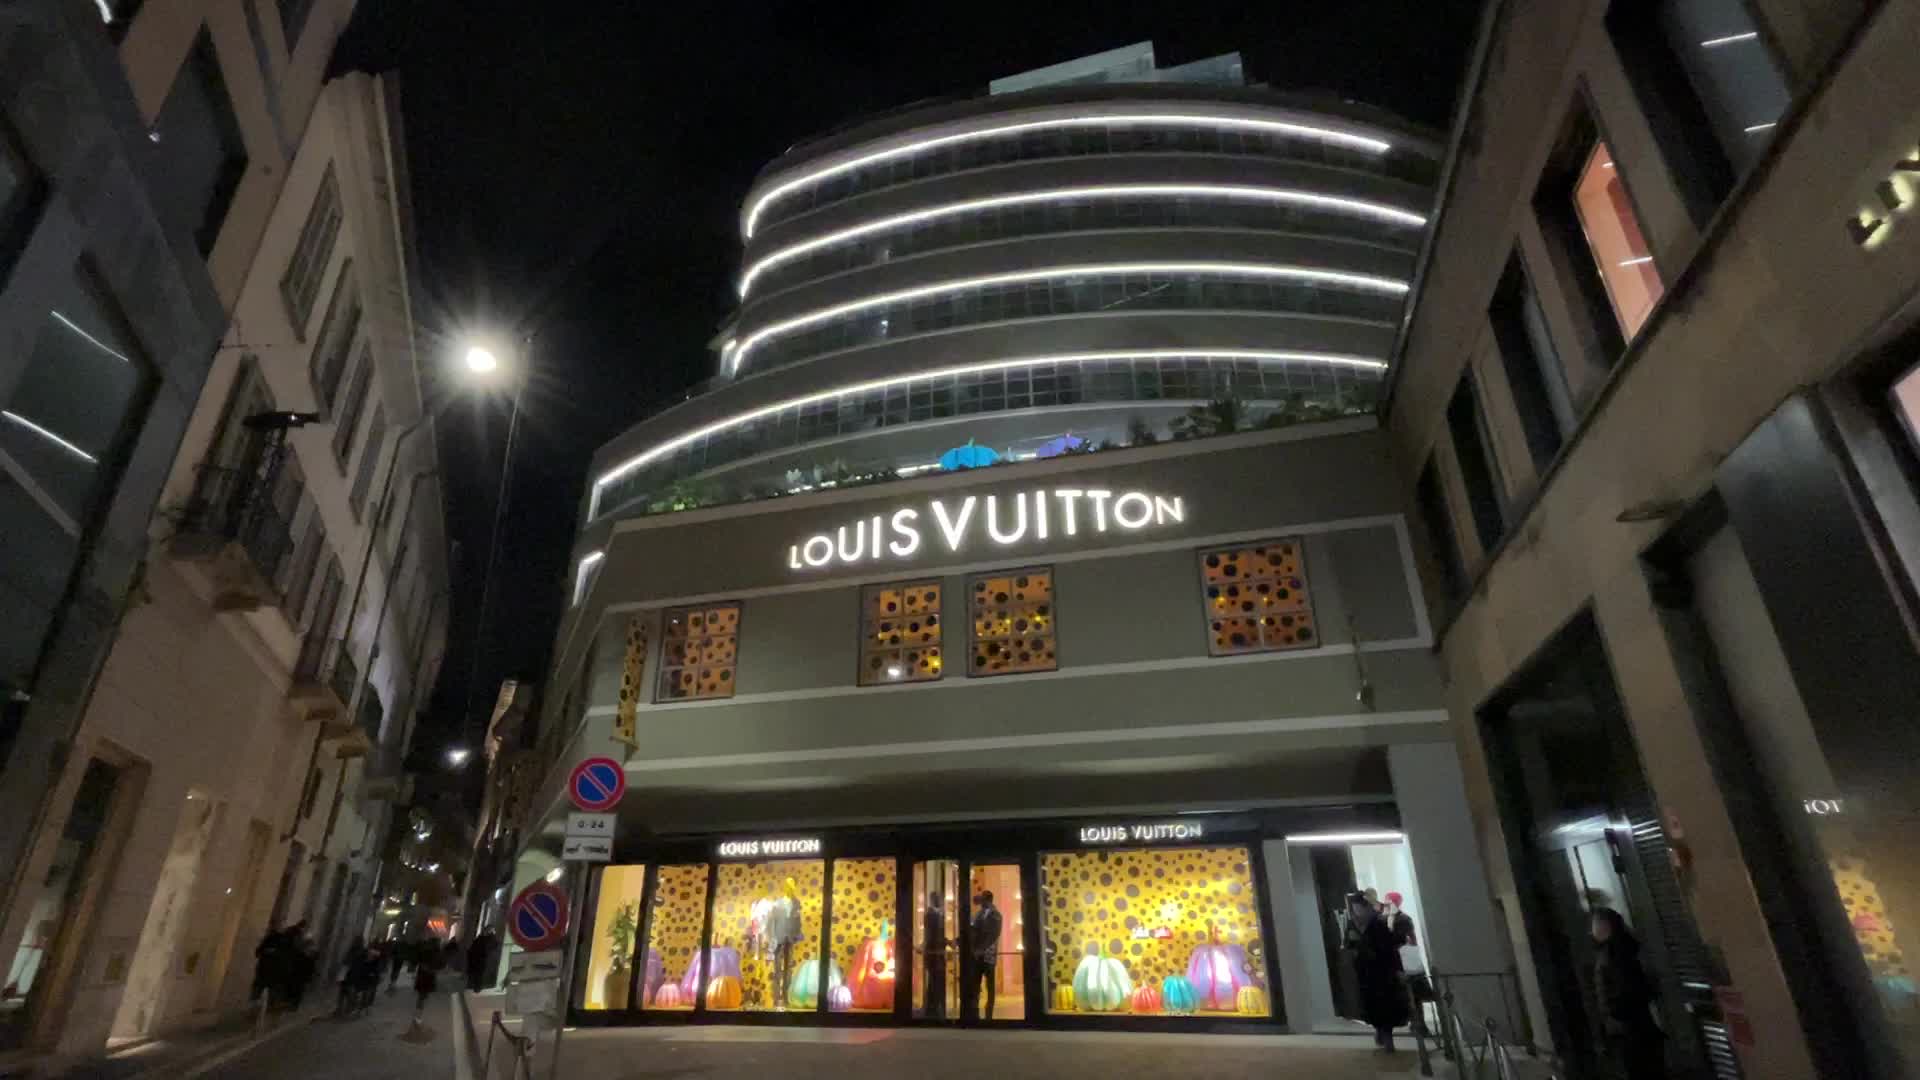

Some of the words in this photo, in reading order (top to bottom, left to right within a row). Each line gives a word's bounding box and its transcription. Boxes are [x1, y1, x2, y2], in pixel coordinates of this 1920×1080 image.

[788, 508, 921, 569] LOUIS
[931, 489, 1184, 552] VUITTON
[1080, 826, 1128, 842] LOUIS
[1131, 823, 1202, 840] VUITTON
[719, 840, 759, 856] LOUIS
[761, 838, 820, 855] VUITTON
